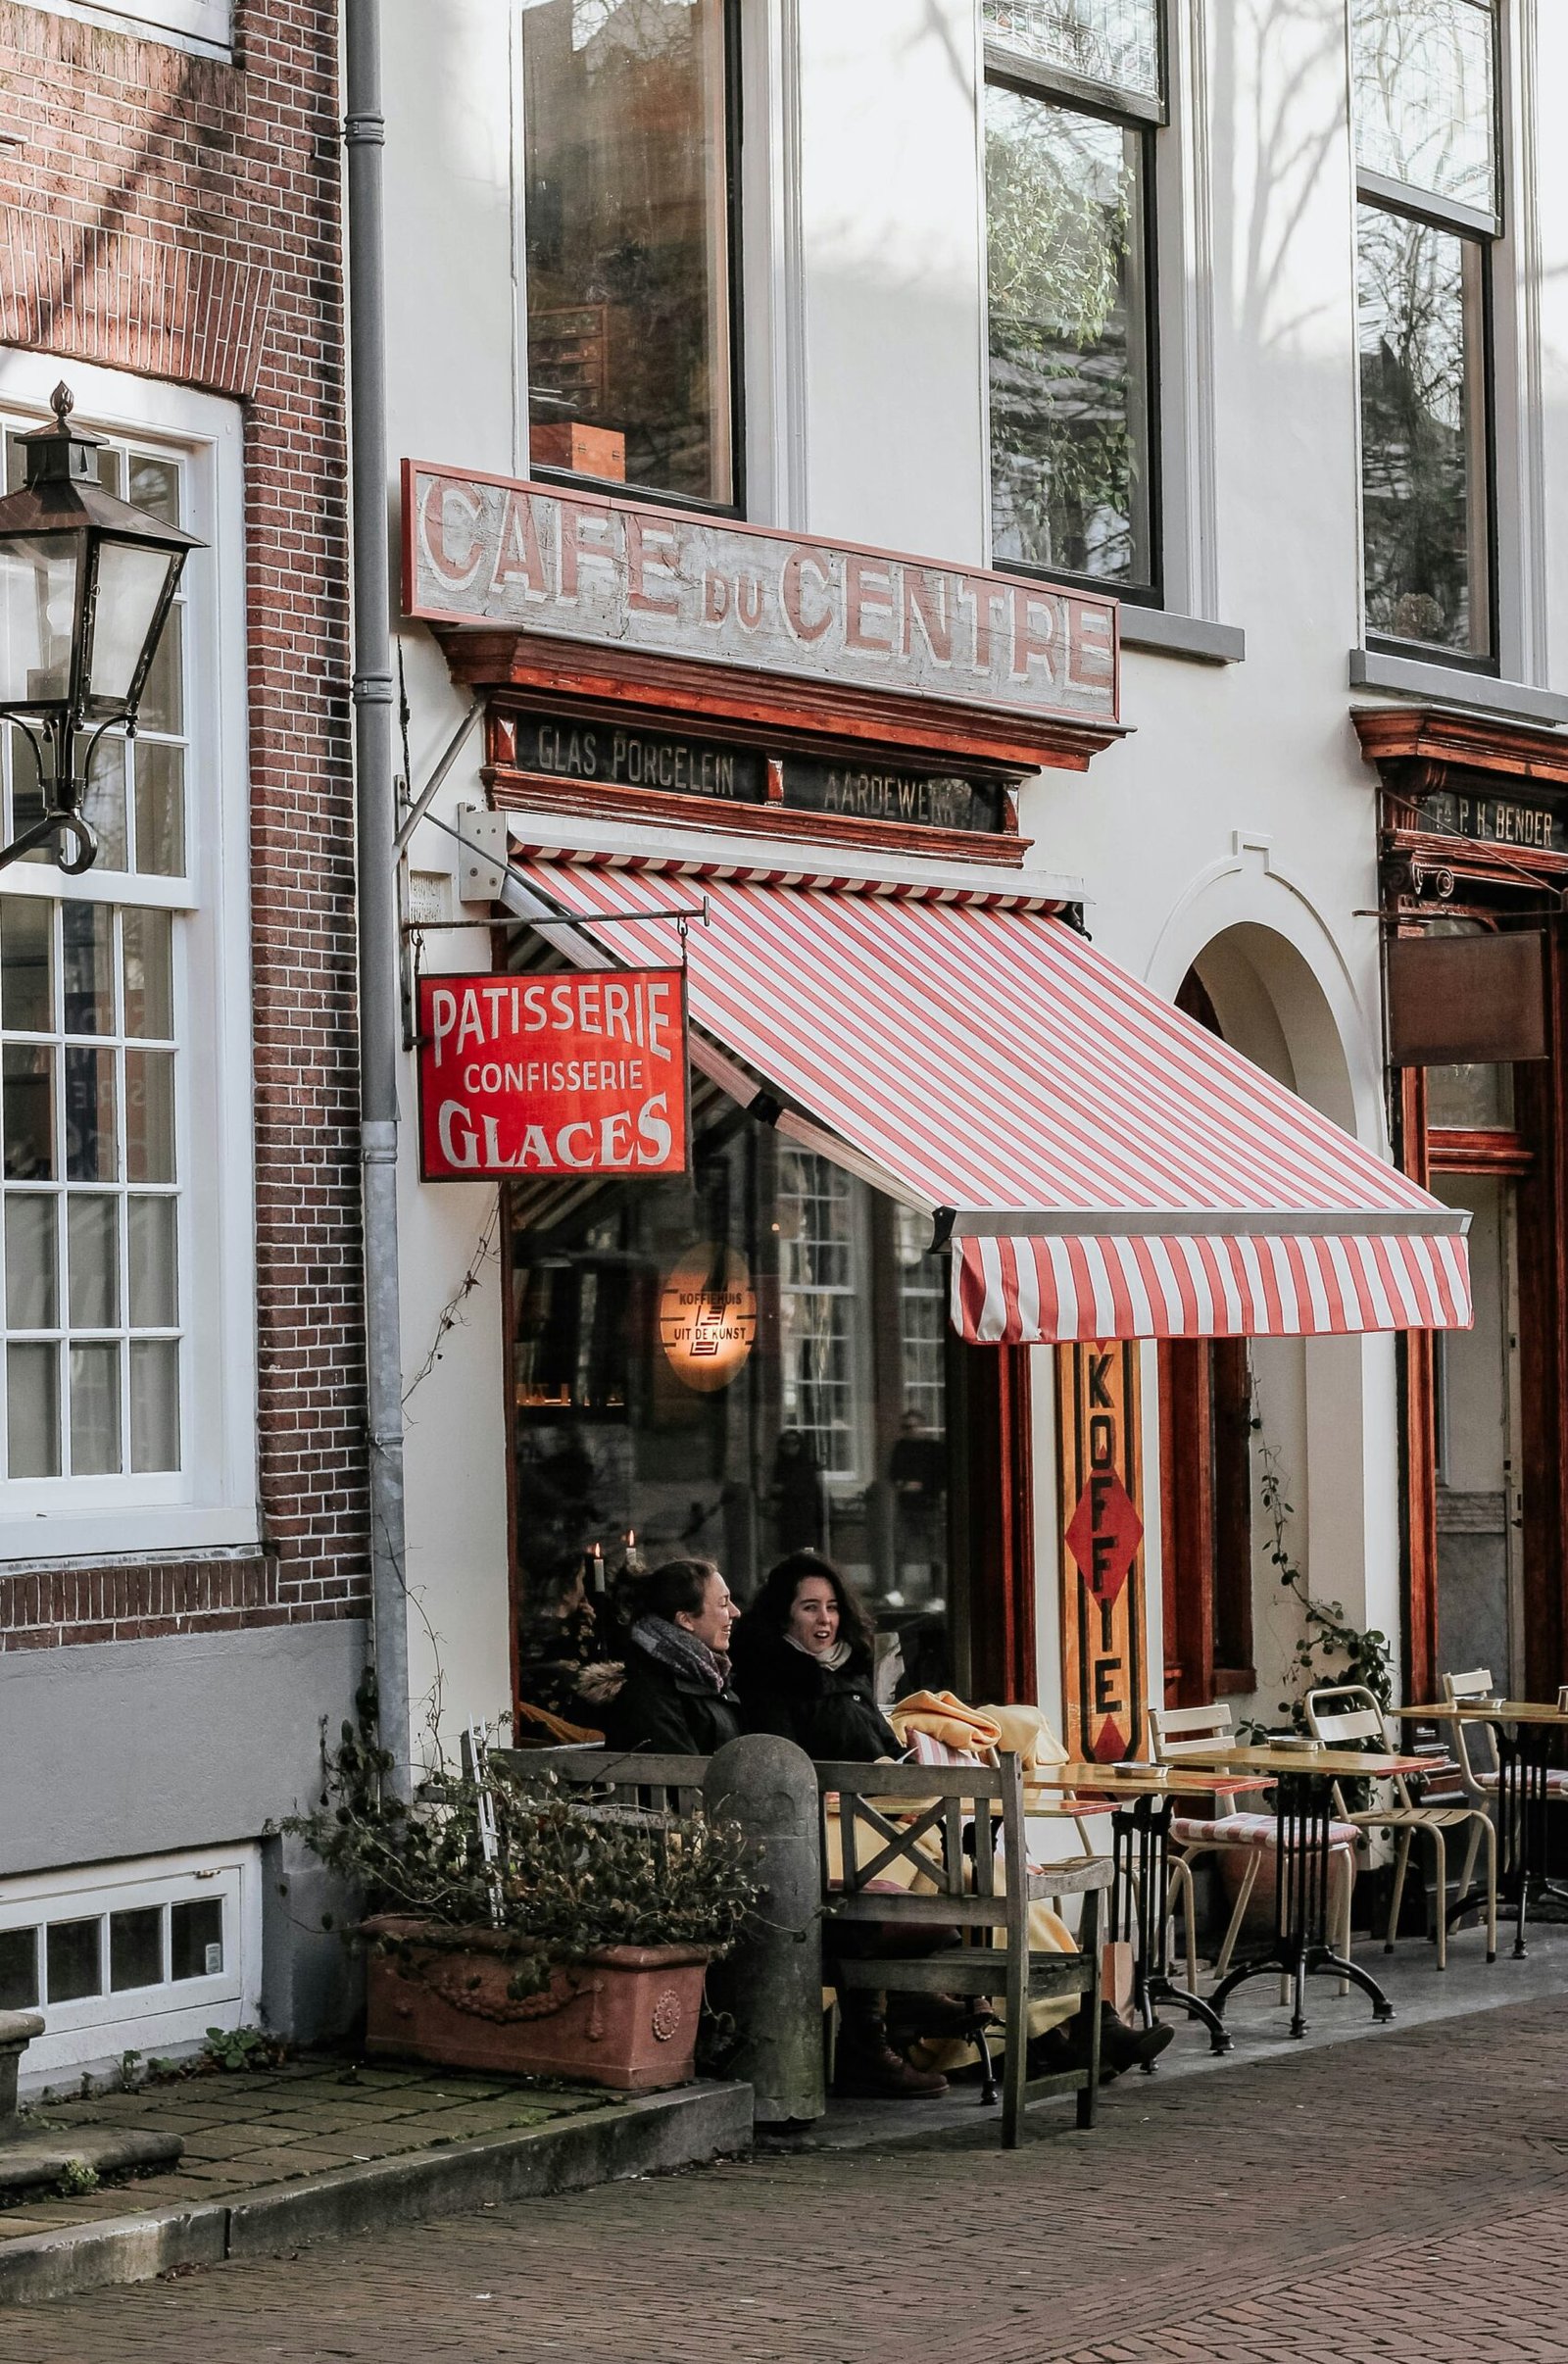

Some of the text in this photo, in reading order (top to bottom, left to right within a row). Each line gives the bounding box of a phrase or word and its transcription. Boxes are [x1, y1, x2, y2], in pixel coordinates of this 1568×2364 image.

[419, 476, 1114, 695] CAFE DU CENTRE
[539, 724, 734, 796] GLAS PORCELEIN
[1495, 804, 1552, 847] BENDER
[432, 983, 672, 1068] PATISSERIE
[464, 1059, 643, 1094] CONFISSERIE
[438, 1092, 672, 1168] GLACES
[674, 1327, 746, 1340] UIT DE KUNST
[679, 1293, 742, 1305] KOFFIEHUIS
[1089, 1354, 1122, 1715] KOFFIE
